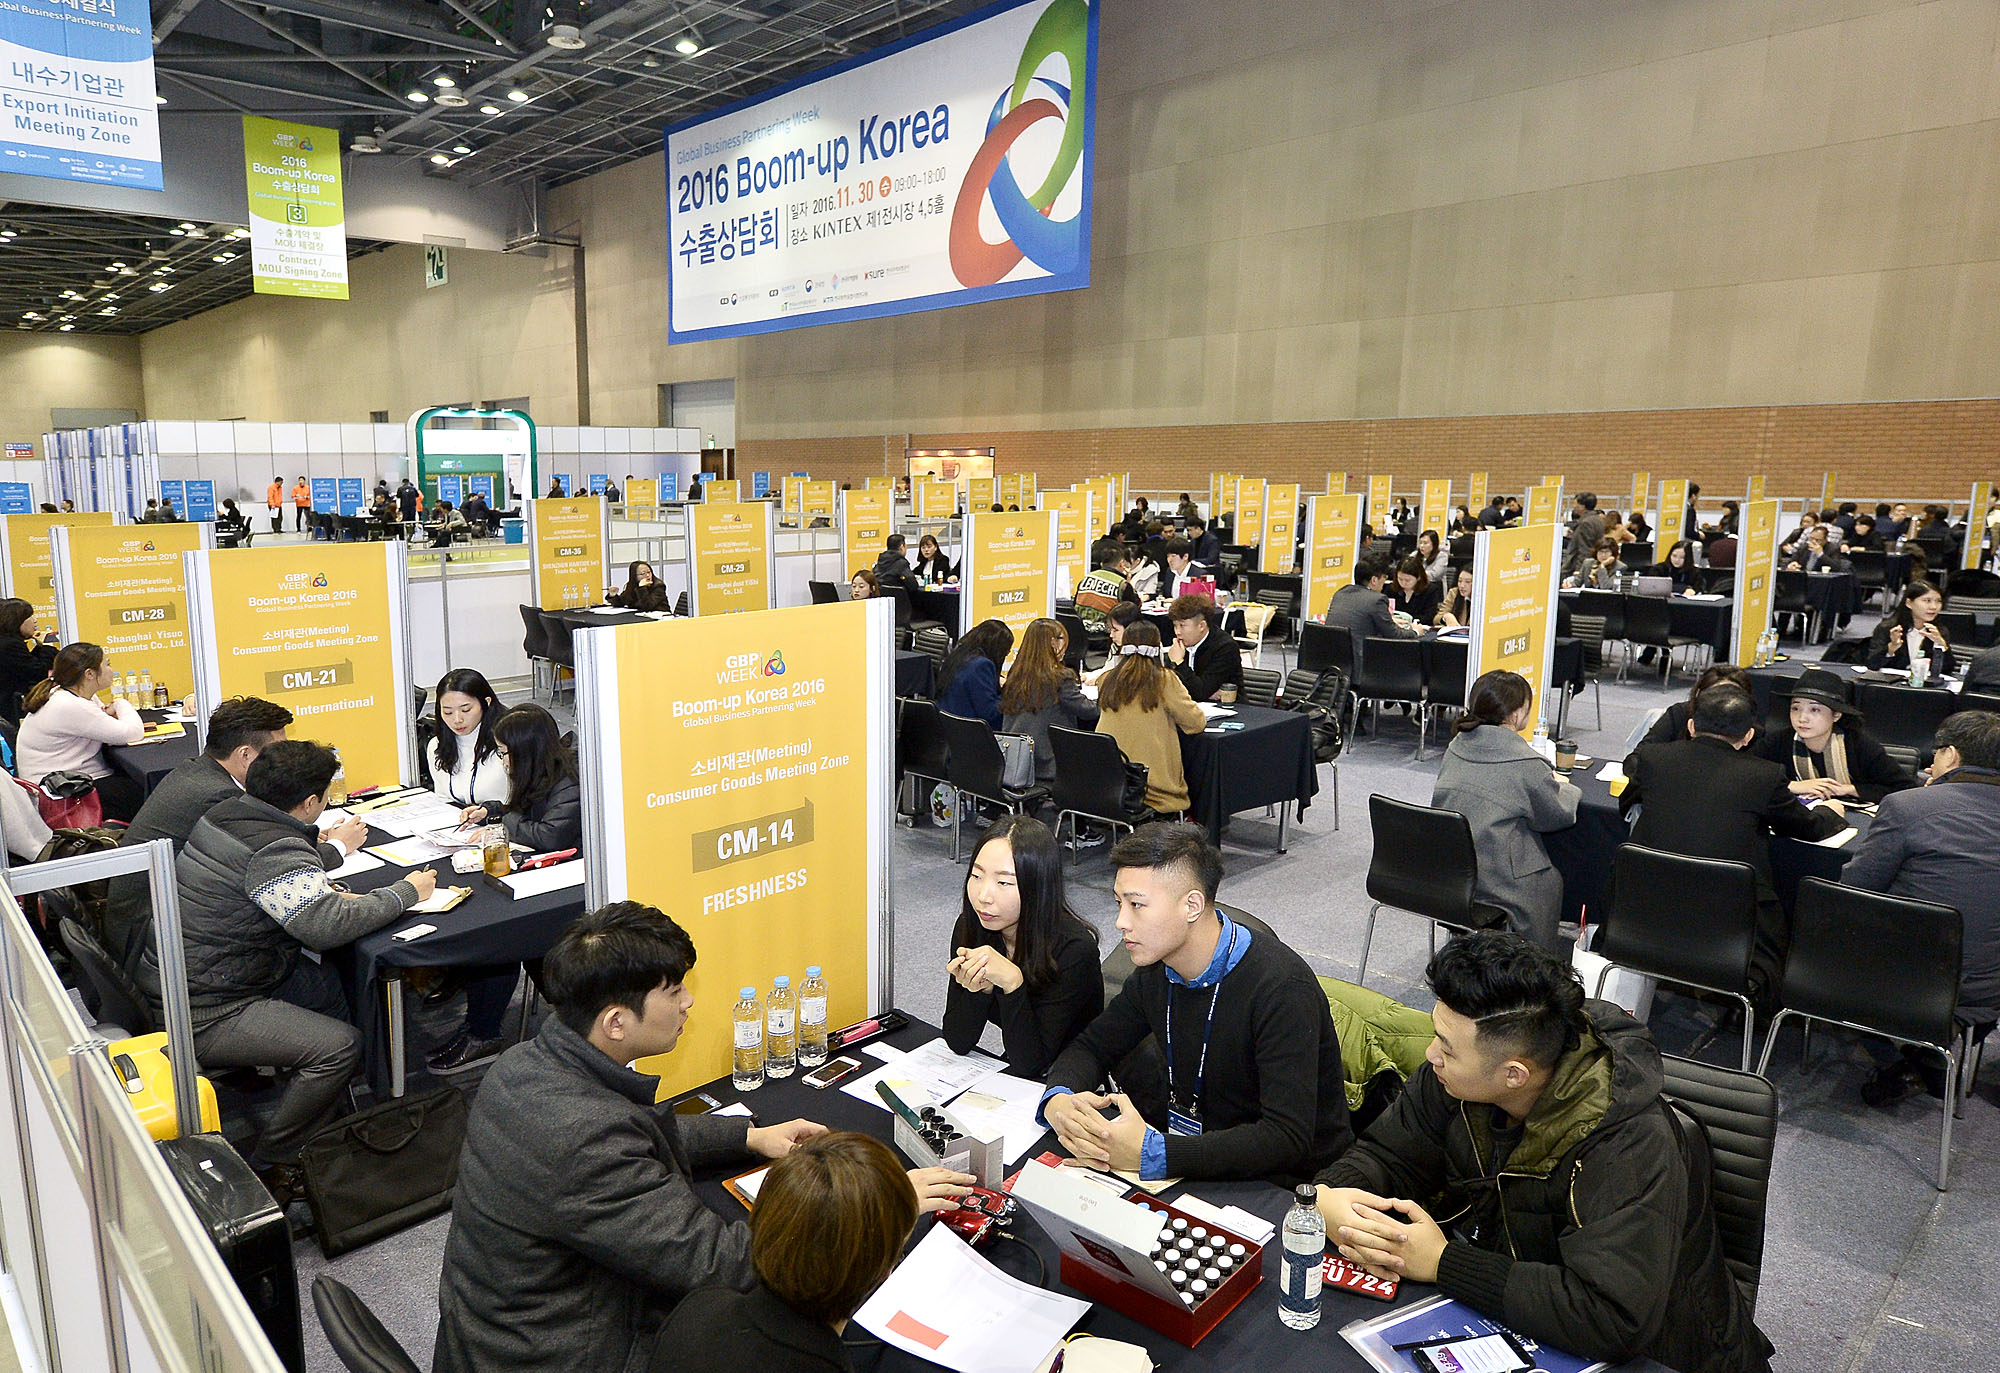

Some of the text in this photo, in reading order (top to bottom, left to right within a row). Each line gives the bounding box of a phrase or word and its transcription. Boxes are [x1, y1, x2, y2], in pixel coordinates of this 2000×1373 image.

[21, 5, 64, 20] Business
[65, 13, 115, 32] Partnering
[117, 24, 142, 35] Week
[12, 61, 125, 98] 내수기업관
[3, 93, 138, 127] Export Initiation
[15, 115, 131, 144] Meeting Zone
[677, 105, 821, 164] Global Business Partnering Week
[281, 155, 307, 168] 2016
[678, 103, 950, 214] 2016 Boom-up Korea
[253, 162, 336, 183] Boom-up Korea
[293, 208, 302, 219] 3
[791, 201, 808, 220] 일자
[679, 207, 778, 268] 수출상담회
[791, 227, 808, 246] 장소
[813, 215, 862, 240] KINTEX
[275, 239, 296, 247] MOU
[279, 254, 317, 266] Contract
[259, 263, 343, 279] MOU Signing Zone
[96, 556, 132, 564] Boom-up
[134, 554, 157, 562] Korea
[721, 563, 745, 574] CM-29
[278, 582, 308, 590] WEEK
[284, 573, 309, 582] GBP
[85, 590, 121, 598] Consumer
[123, 588, 146, 596] Goods
[147, 585, 176, 593] Meeting
[248, 590, 357, 607] Boom-up Korea 2016
[998, 591, 1024, 604] CM-22
[122, 608, 165, 622] CM-28
[106, 630, 183, 645] Shanghai Yisuo
[262, 623, 350, 641] 소비재관(Meeting)
[103, 642, 148, 655] Garments
[170, 638, 187, 648] Ltd.
[232, 634, 379, 656] Consumer Goods Meeting Zone
[1504, 637, 1526, 655] CM-15
[725, 652, 759, 669] GBP
[282, 669, 337, 689] CM-21
[716, 666, 758, 685] WEEK
[296, 695, 374, 716] International
[672, 677, 825, 718] Boom-up Korea 2016
[682, 697, 817, 728] Global Business Partnering Week
[690, 737, 813, 777] 소비재관(Meeting)
[646, 753, 850, 809] Consumer Goods Meeting Zone
[717, 818, 795, 860] CM-14
[703, 867, 808, 916] FRESHNESS
[1347, 1270, 1393, 1296] 724
